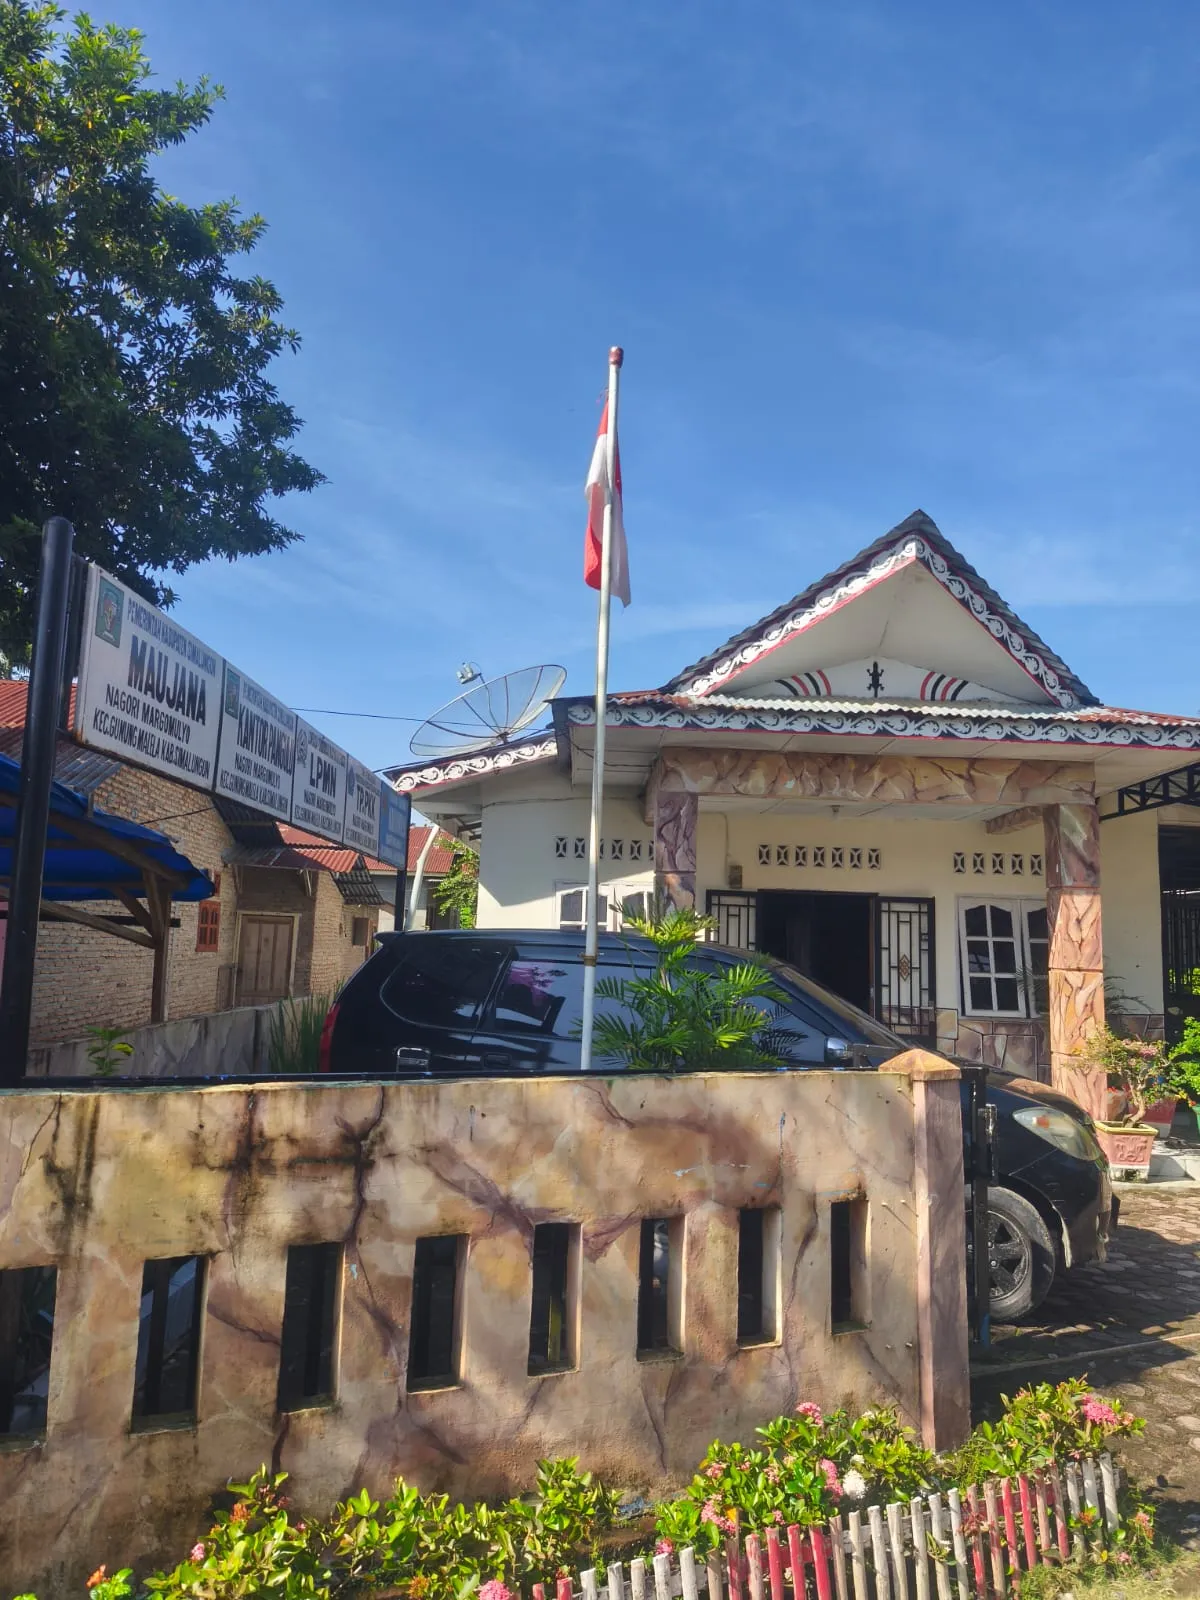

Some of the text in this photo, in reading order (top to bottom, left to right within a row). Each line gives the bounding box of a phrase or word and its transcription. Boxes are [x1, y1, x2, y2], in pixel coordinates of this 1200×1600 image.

[127, 632, 208, 726] MAUJANA
[105, 683, 191, 745] NAGORI MARGOMULYO
[236, 702, 269, 761] KANTOR
[308, 750, 337, 799] LPMN
